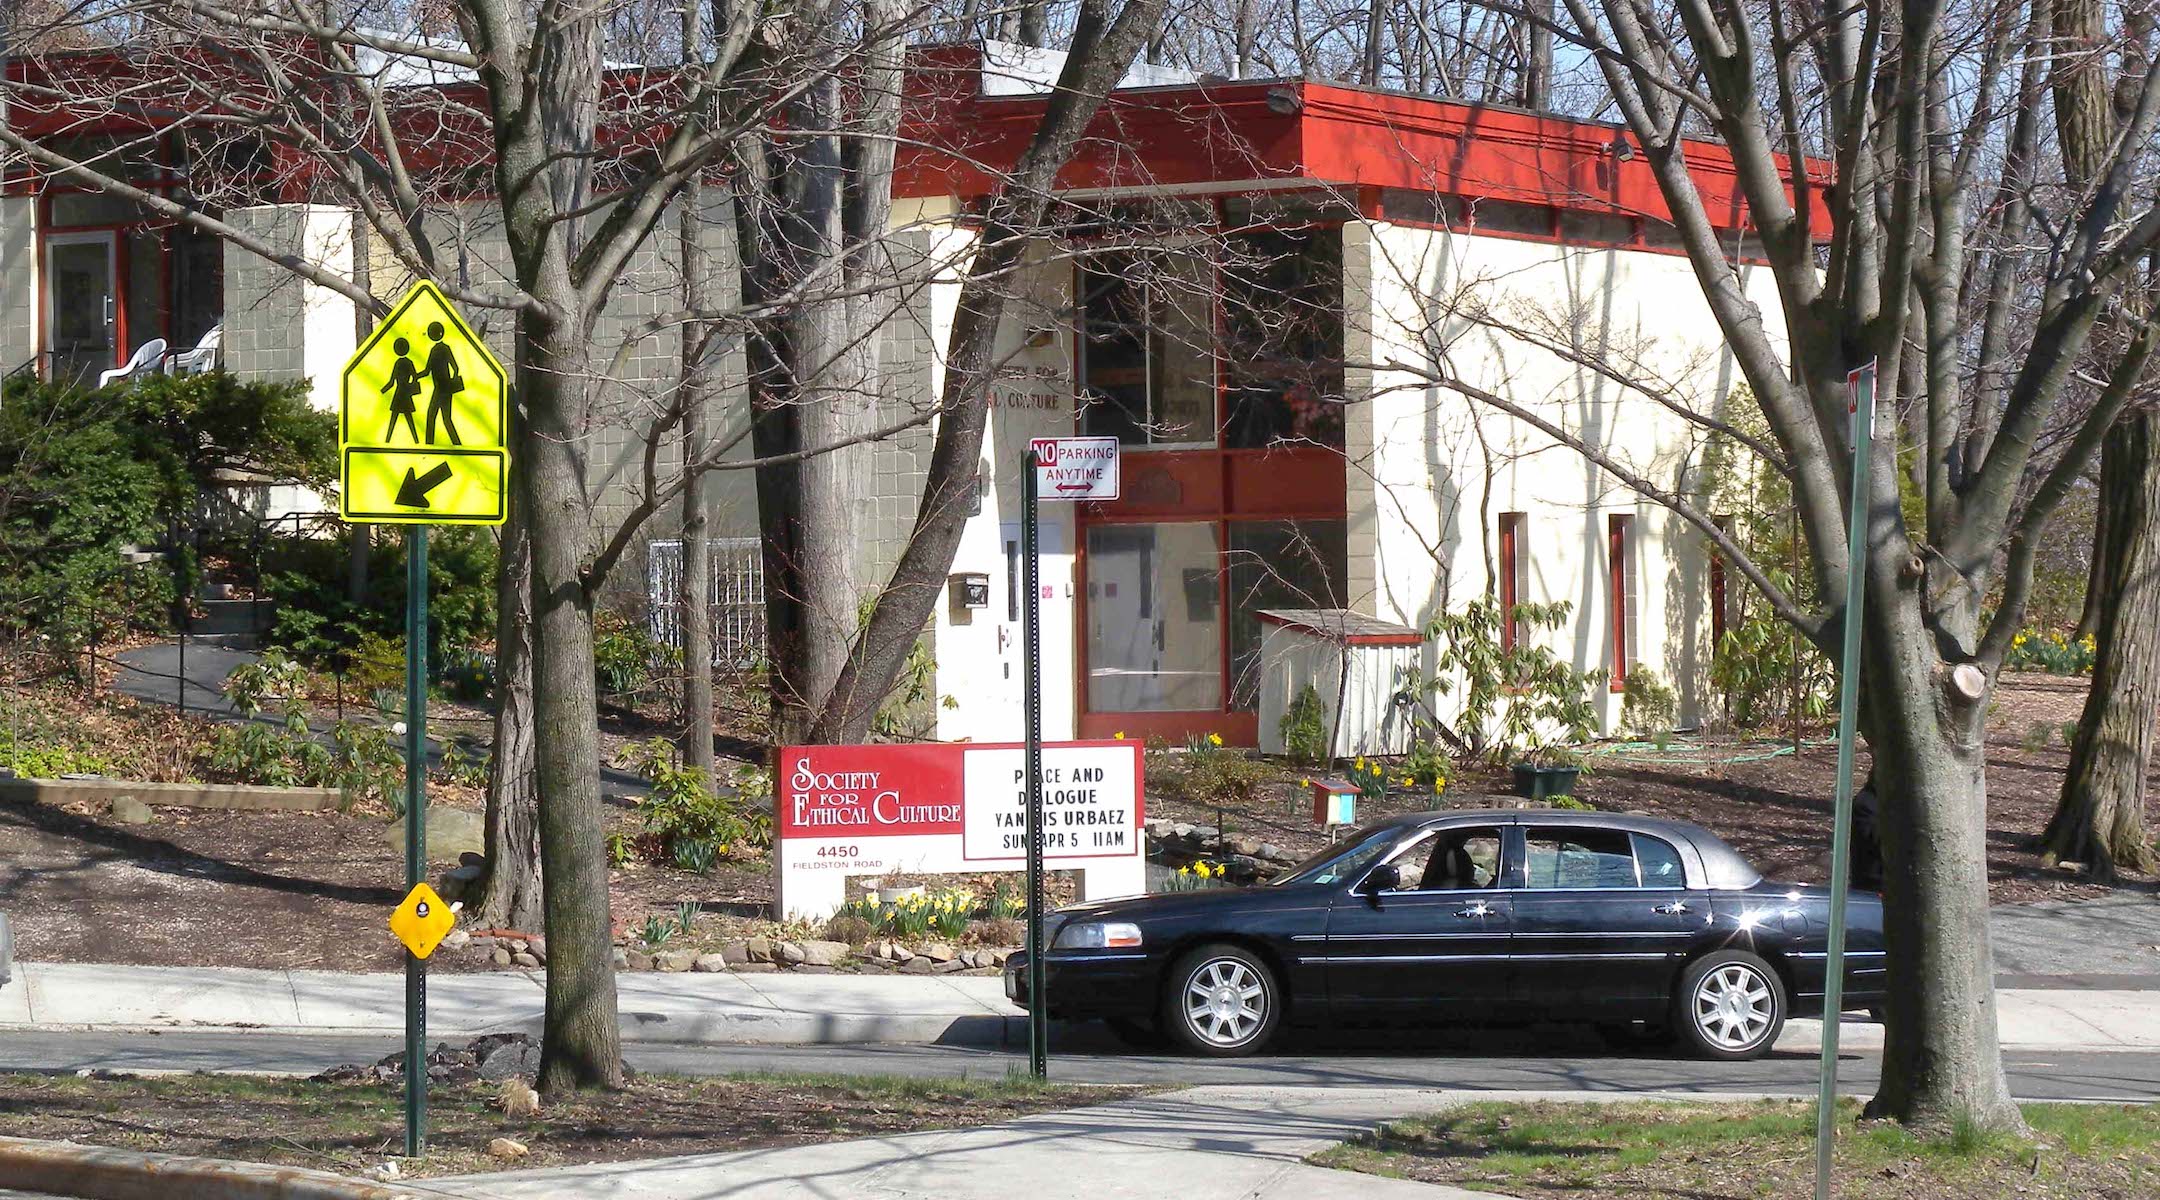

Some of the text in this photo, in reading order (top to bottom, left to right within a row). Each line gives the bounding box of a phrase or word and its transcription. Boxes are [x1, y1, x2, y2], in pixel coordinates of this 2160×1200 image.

[1033, 442, 1114, 464] NO PARKING
[1046, 468, 1104, 481] ANYTIME
[1014, 768, 1104, 784] PCE AND
[820, 793, 859, 806] FOR
[995, 809, 1124, 828] YANIS URBAEZ
[1040, 832, 1065, 848] APR
[1071, 832, 1078, 847] 5
[817, 845, 859, 858] 4450
[792, 860, 883, 870] FIELDSTON ROAD
